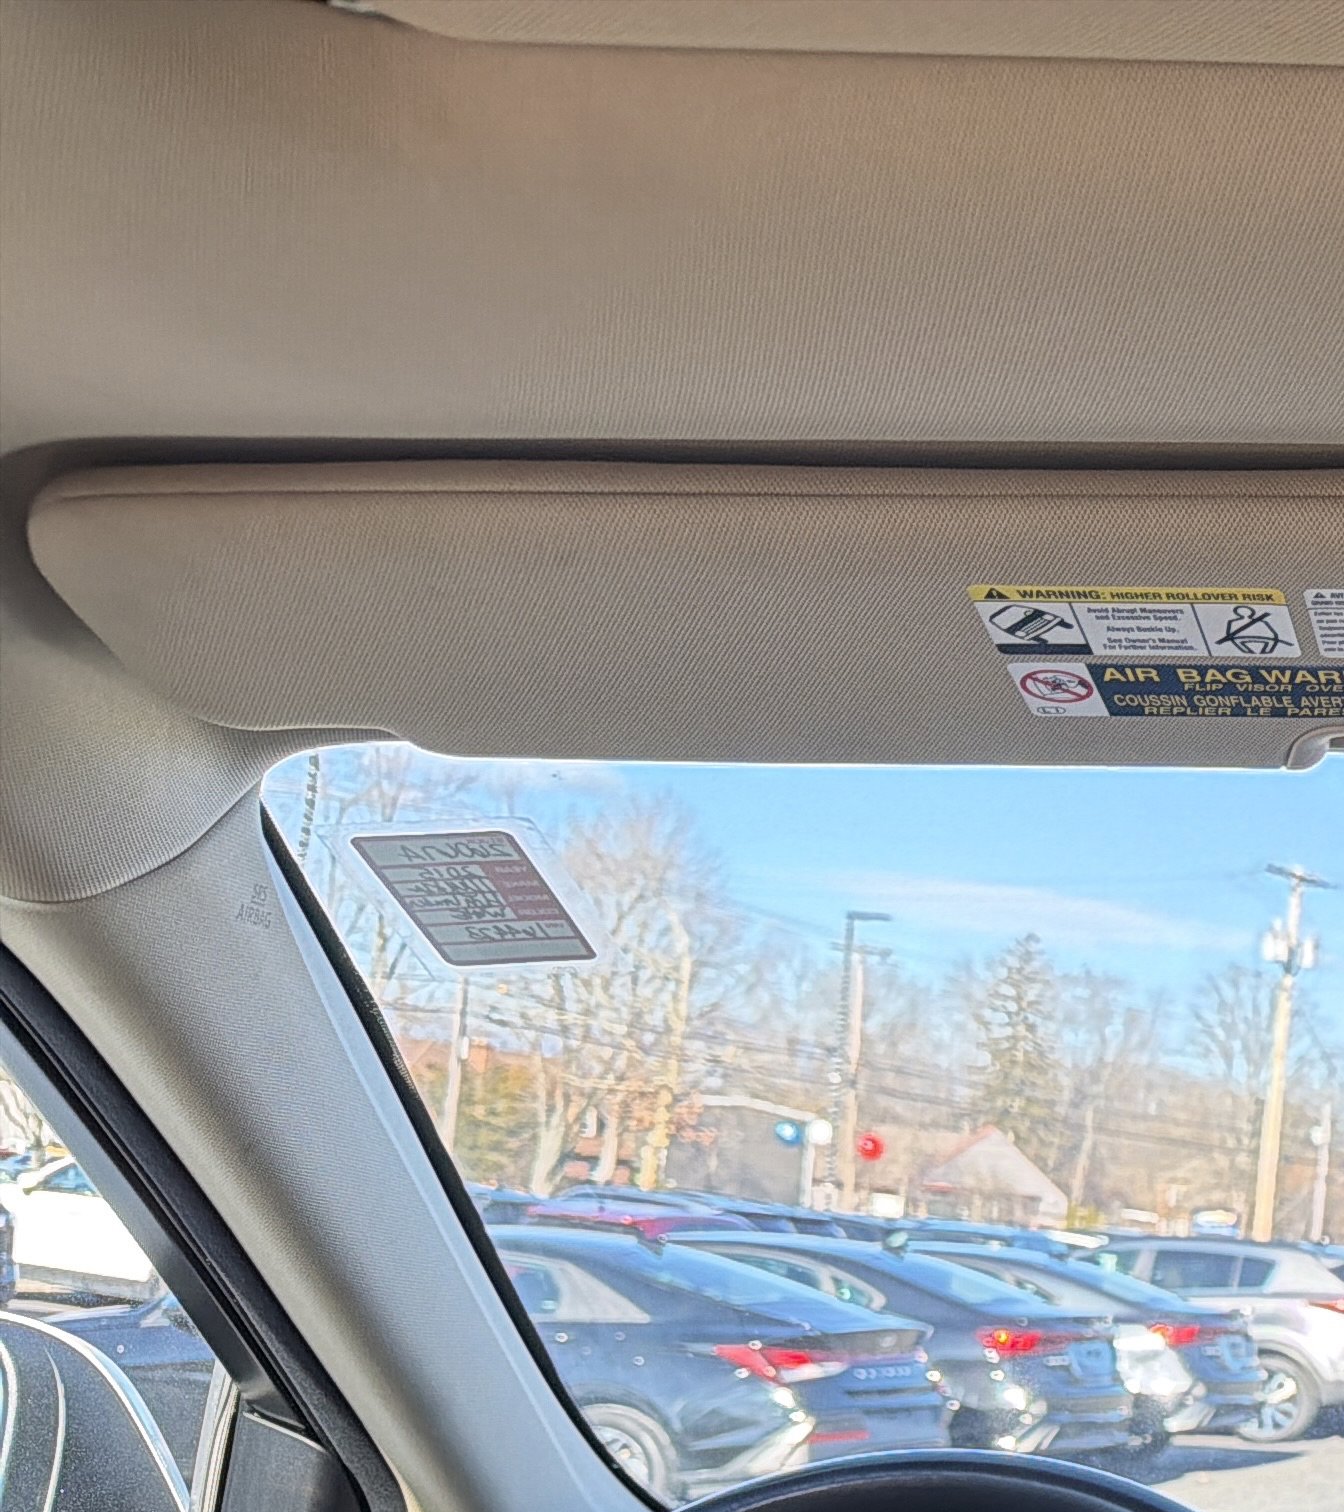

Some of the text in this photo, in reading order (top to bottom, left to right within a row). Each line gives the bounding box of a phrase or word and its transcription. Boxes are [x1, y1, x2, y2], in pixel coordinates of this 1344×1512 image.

[1016, 589, 1275, 602] WARNING: HIGHER ROLLOVER RISK
[1103, 668, 1161, 683] AIR
[1177, 669, 1253, 685] BAG
[1184, 683, 1224, 691] FLIP
[1237, 684, 1292, 692] VISOR
[1113, 694, 1188, 707] COUSSIN
[1193, 695, 1293, 708] GONFLABLE
[1144, 706, 1226, 715] REPLIER
[1247, 707, 1272, 715] LE
